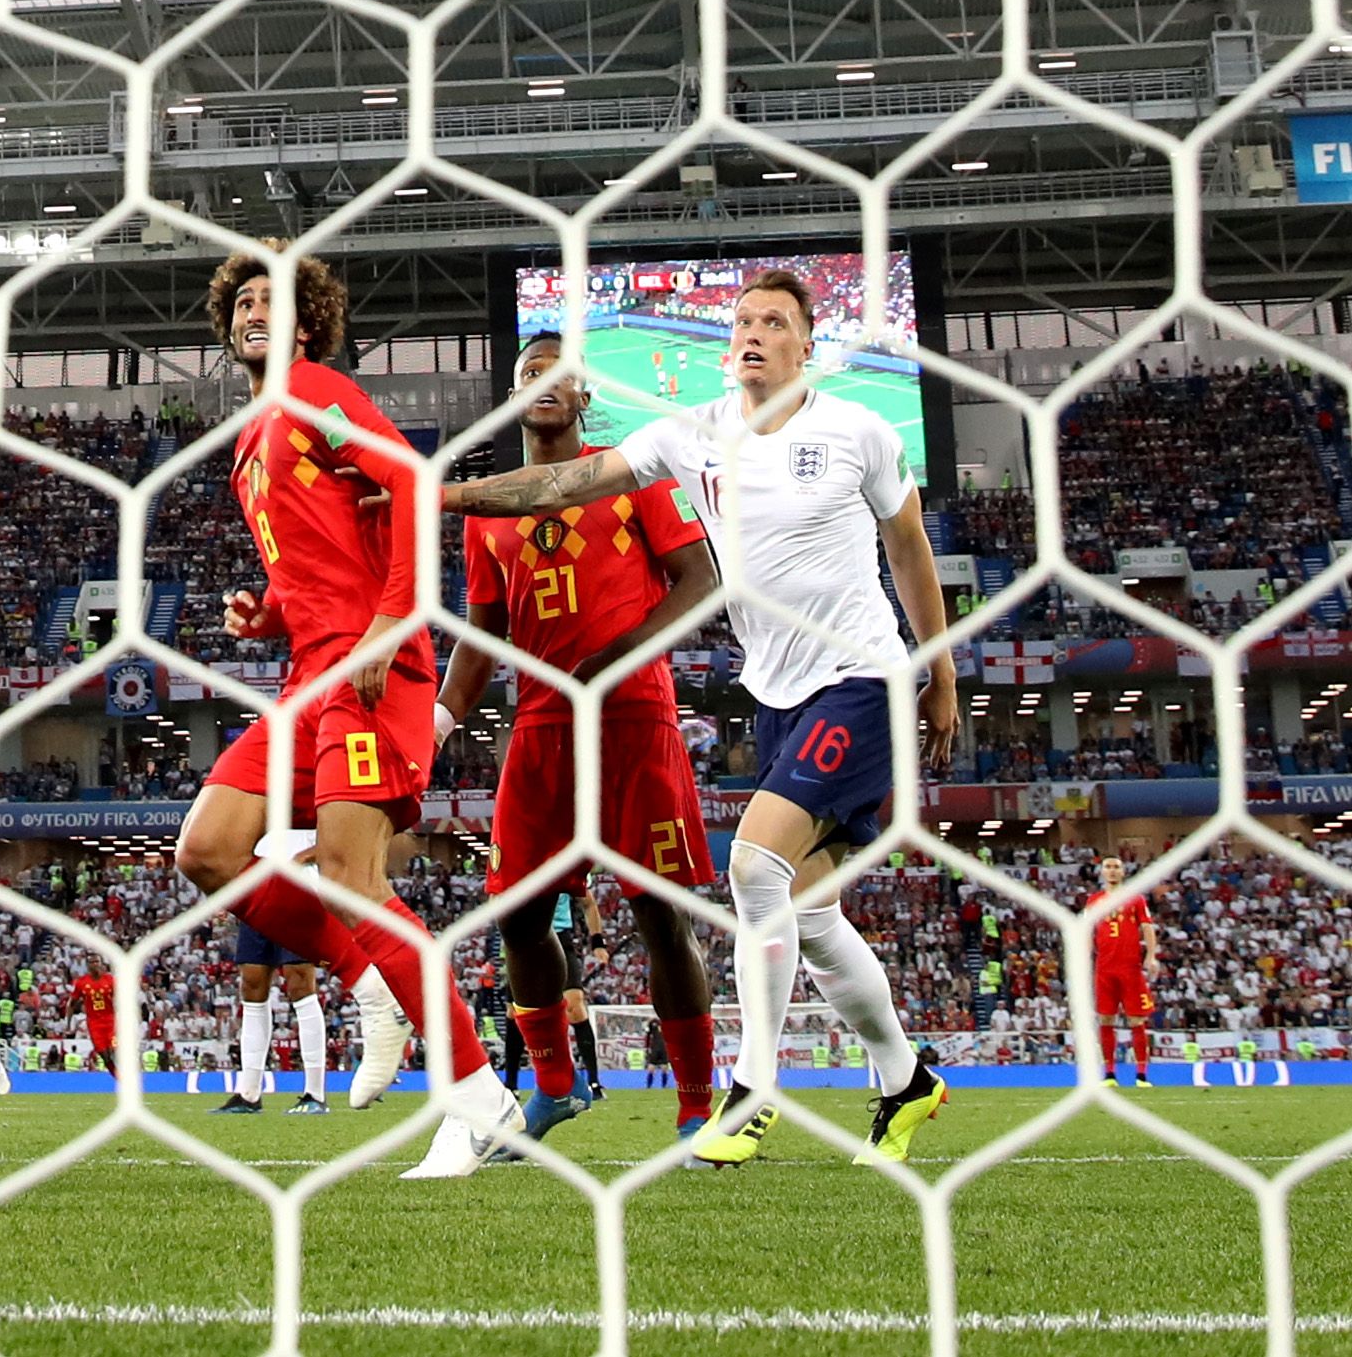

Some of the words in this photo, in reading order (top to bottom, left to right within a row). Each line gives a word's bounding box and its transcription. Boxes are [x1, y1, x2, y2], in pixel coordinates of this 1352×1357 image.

[255, 509, 280, 565] 8
[533, 564, 578, 620] 21
[345, 732, 381, 786] 8
[797, 718, 852, 773] 16
[21, 812, 100, 828] ФУТБОЛУ
[104, 811, 140, 827] FIFA
[142, 811, 182, 826] 2018
[1282, 786, 1331, 804] FIFA
[650, 818, 695, 874] 21
[1109, 921, 1120, 938] 3
